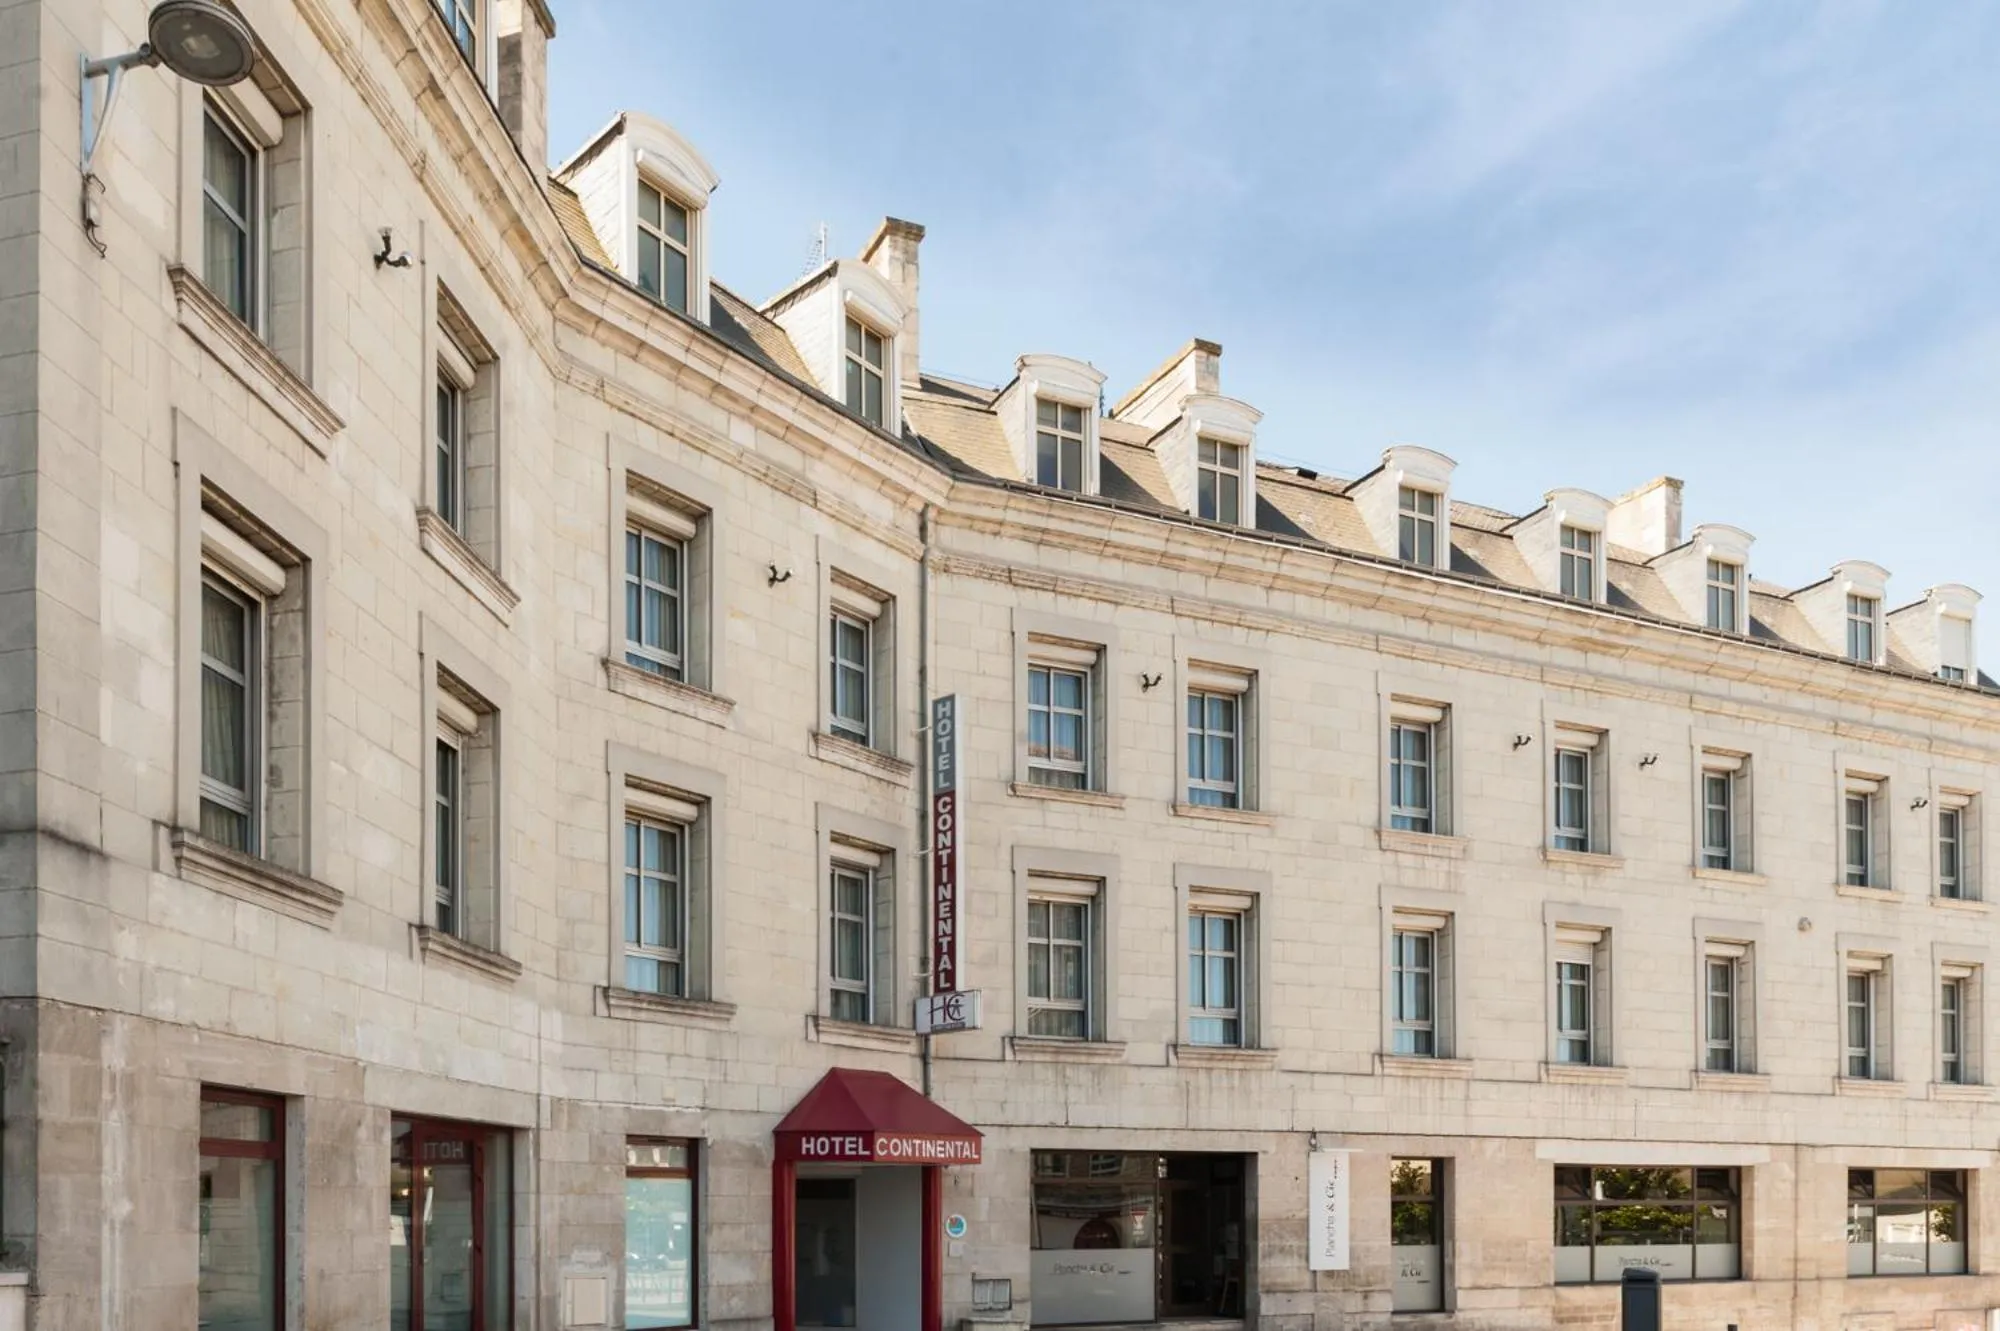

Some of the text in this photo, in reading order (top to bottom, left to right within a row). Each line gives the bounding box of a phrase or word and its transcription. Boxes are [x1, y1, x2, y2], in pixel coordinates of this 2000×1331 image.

[936, 700, 954, 989] HOTEL CONTINENTAL
[801, 1136, 979, 1159] HOTEL CONTINENTAL
